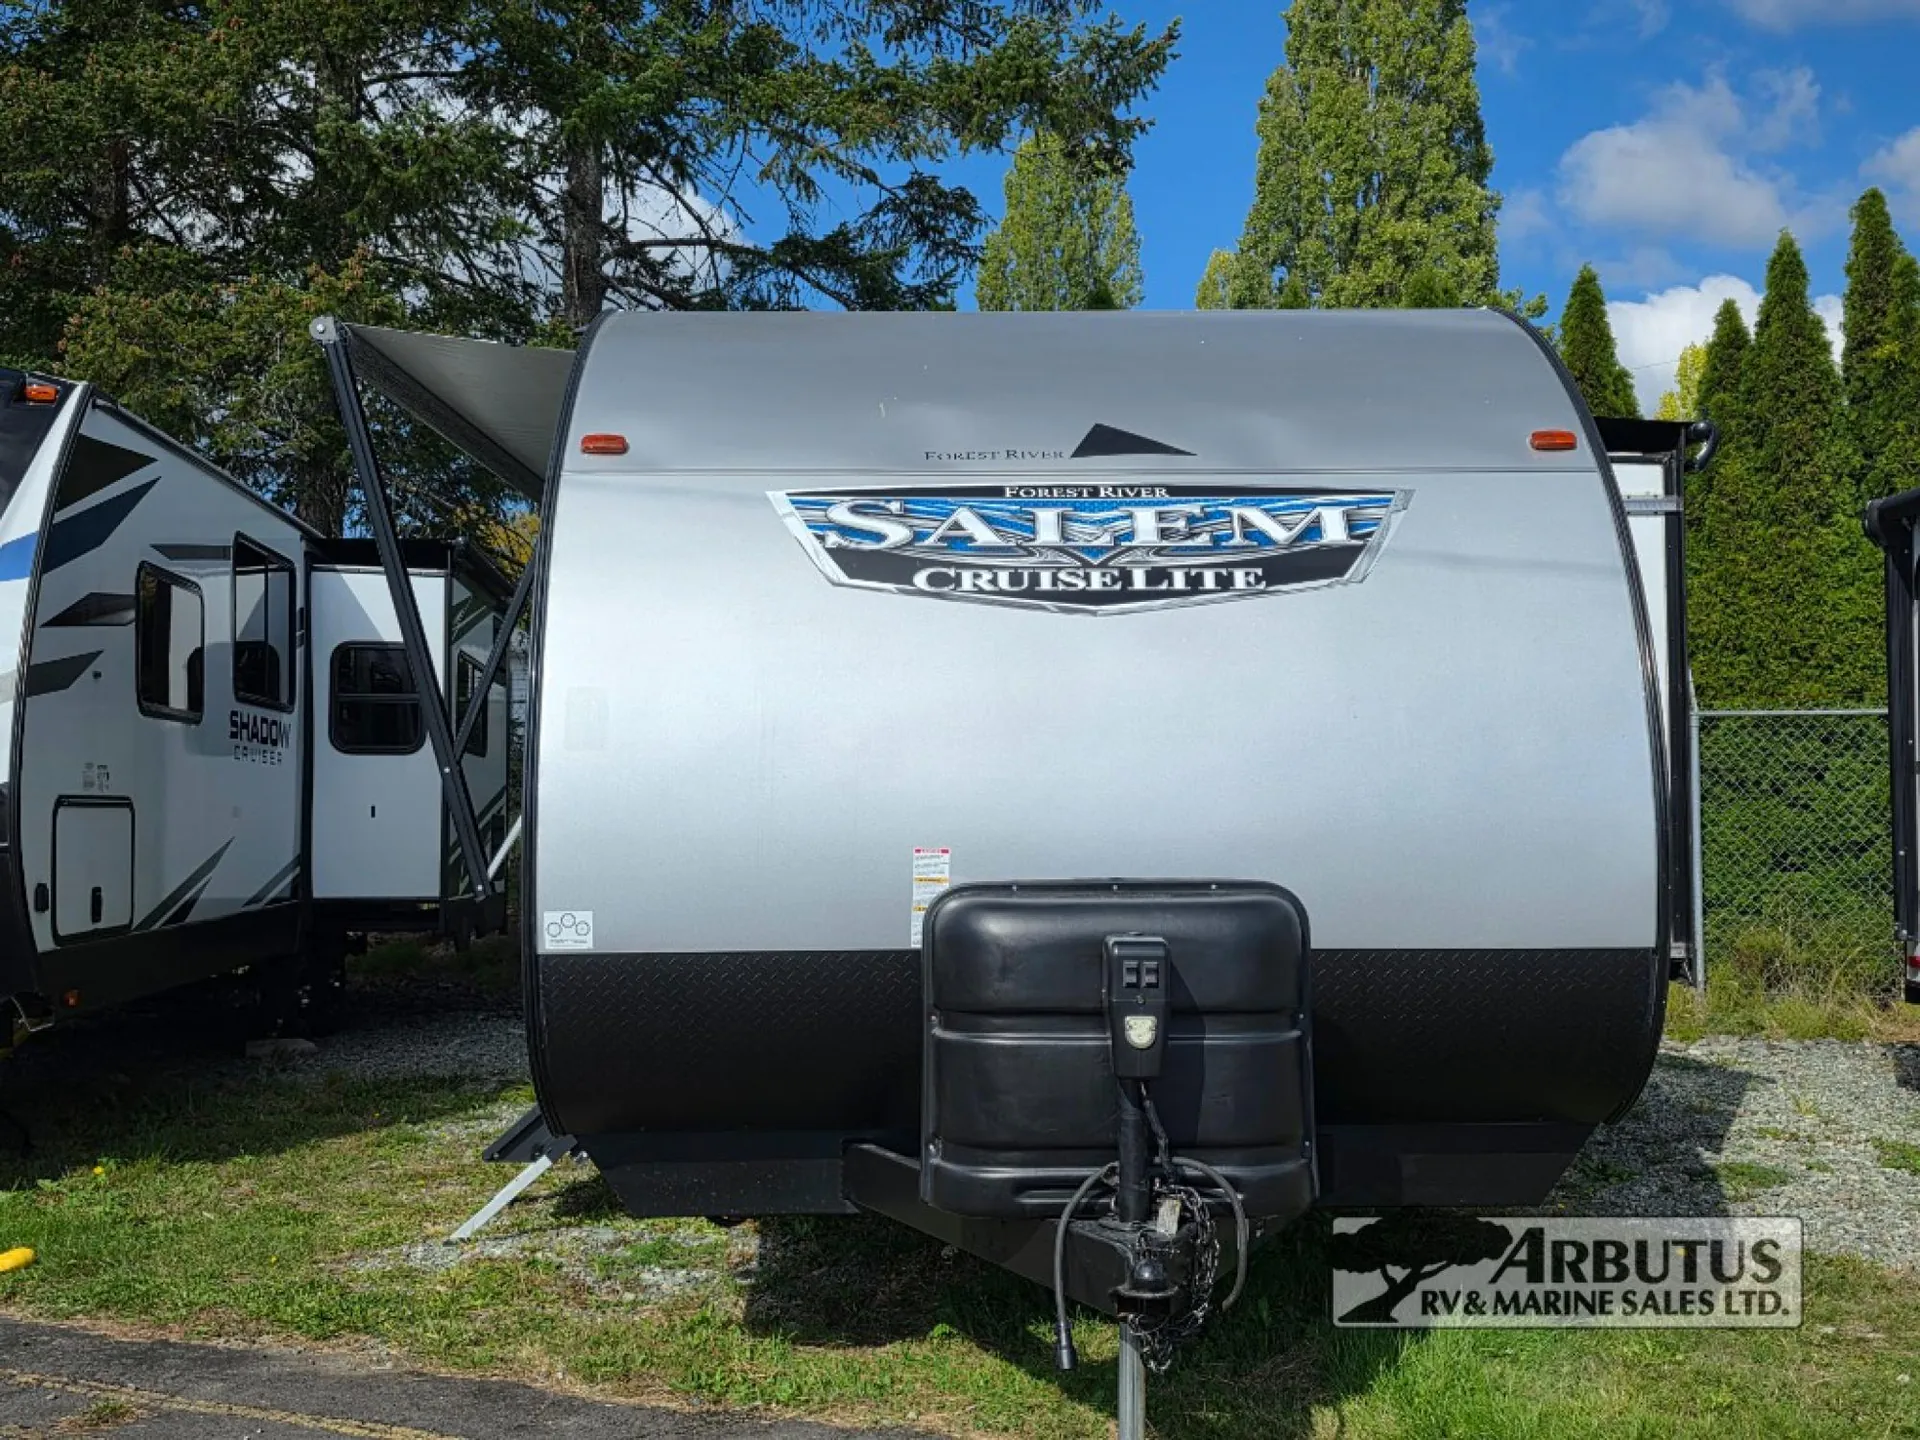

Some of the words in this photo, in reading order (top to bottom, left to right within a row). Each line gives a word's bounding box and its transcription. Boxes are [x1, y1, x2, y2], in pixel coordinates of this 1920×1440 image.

[924, 451, 1000, 460] FOREST
[1005, 449, 1064, 459] RIVER
[1004, 486, 1093, 498] FOREST
[1098, 485, 1170, 498] RIVER
[825, 500, 1363, 549] SALEM
[230, 710, 291, 748] SHADOW
